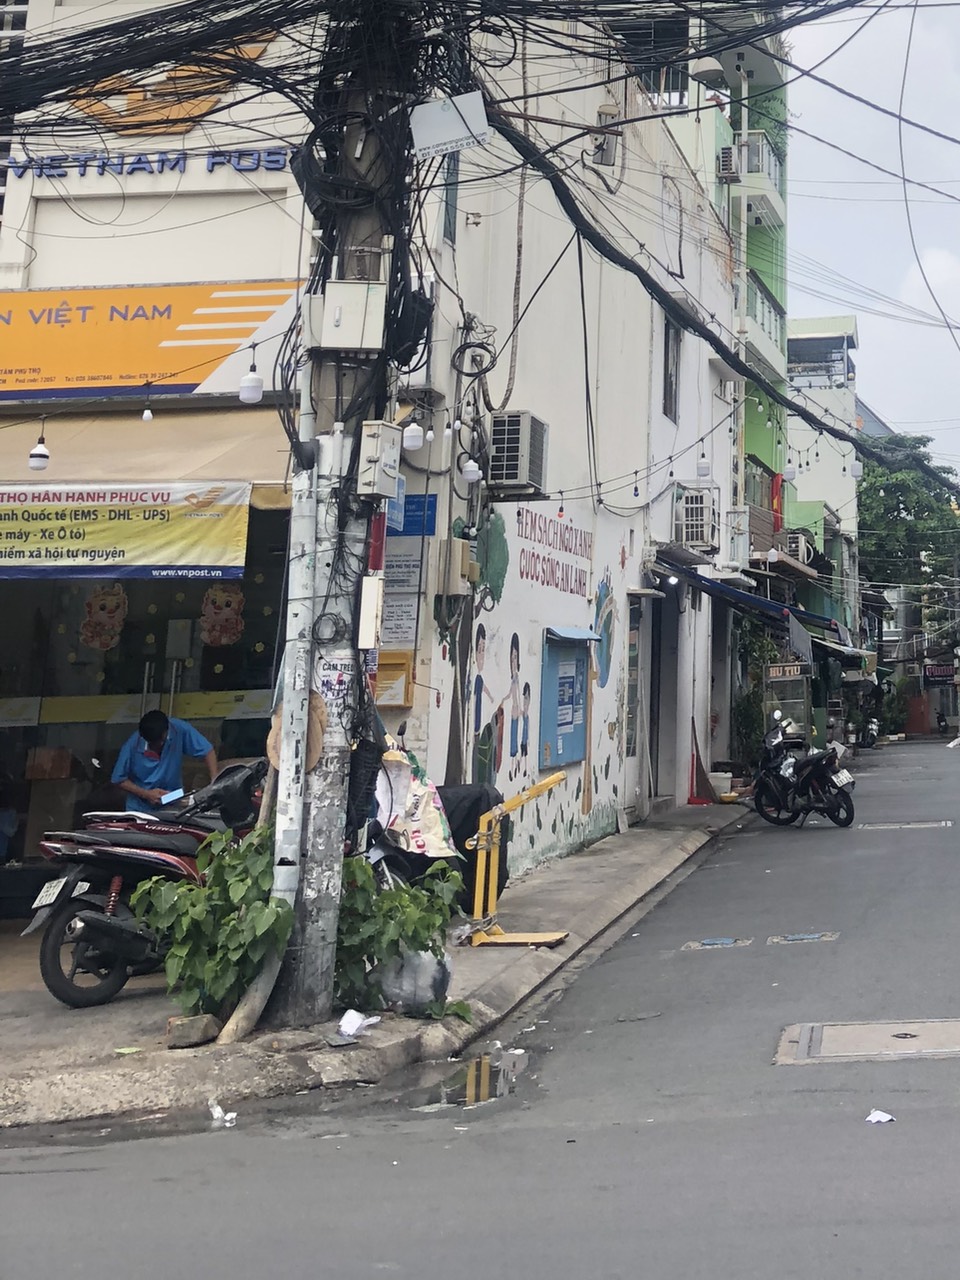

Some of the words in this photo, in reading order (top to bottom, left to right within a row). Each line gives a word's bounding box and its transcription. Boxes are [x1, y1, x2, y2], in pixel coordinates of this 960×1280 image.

[8, 151, 188, 178] VIETNAM
[207, 148, 297, 173] POS
[29, 300, 94, 328] VIỆT
[110, 304, 172, 321] NAM
[0, 492, 27, 505] THỌ
[31, 490, 62, 502] HÂN
[66, 492, 106, 505] HẠNH
[110, 492, 148, 505] PHỤC
[151, 492, 170, 505] VỤ
[21, 508, 52, 522] Quốc
[55, 508, 67, 521] tế
[70, 509, 98, 522] (EMS
[108, 509, 133, 520] DHL
[143, 509, 170, 522] UPS)
[6, 529, 30, 543] máy
[40, 529, 54, 539] Xe
[57, 526, 66, 540] Ô
[28, 547, 41, 558] xã
[45, 547, 63, 561] hội
[66, 548, 79, 561] tự
[82, 547, 125, 561] nguyện
[152, 569, 222, 577] www.vnpost.vn
[559, 562, 570, 592] AN
